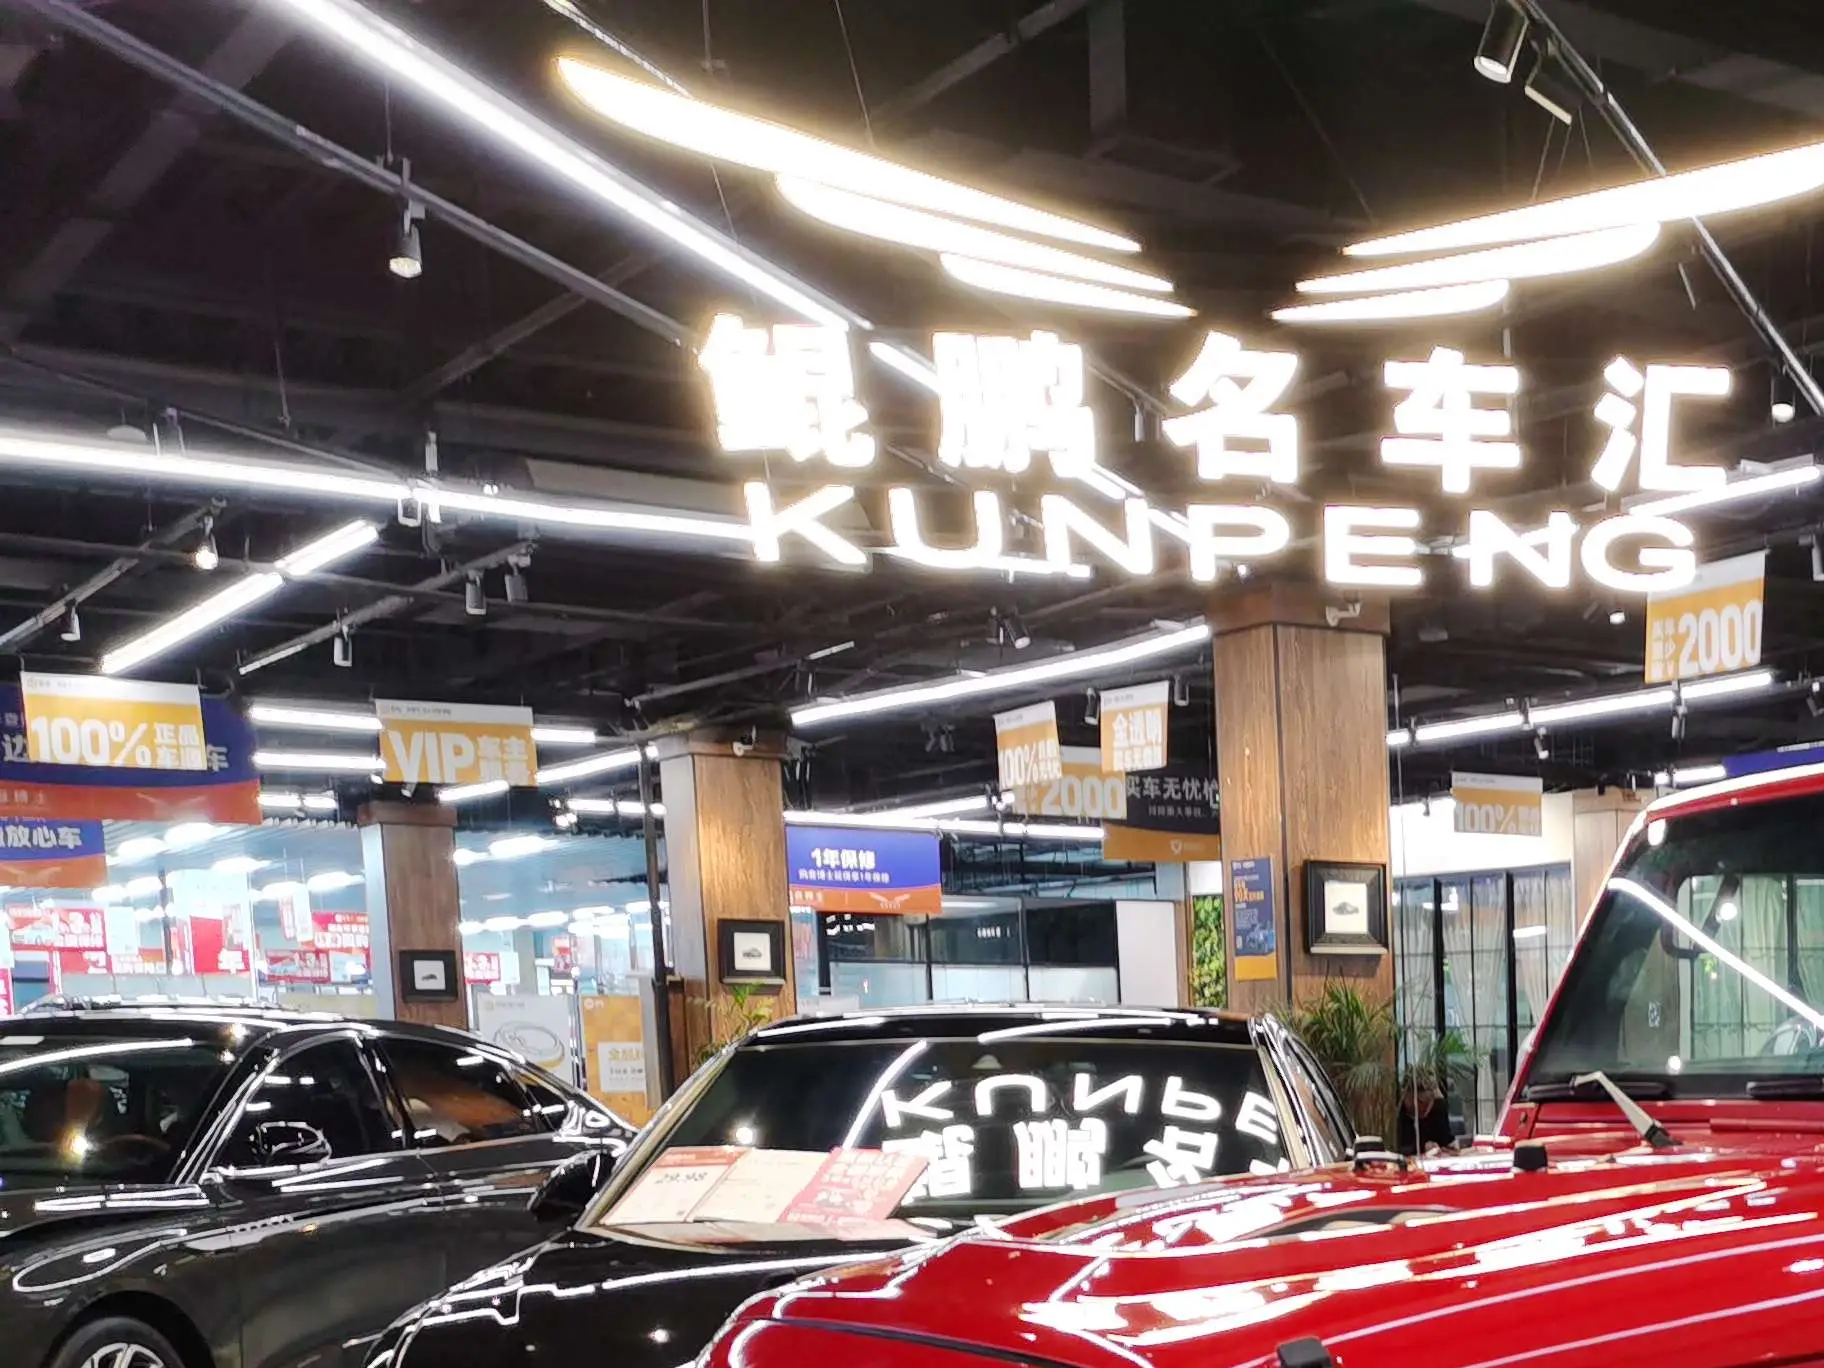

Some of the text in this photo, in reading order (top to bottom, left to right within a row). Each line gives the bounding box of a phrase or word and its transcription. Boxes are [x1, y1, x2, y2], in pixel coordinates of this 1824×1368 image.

[696, 310, 1734, 495] 鲲鹏名车汇
[739, 480, 1704, 594] KUNPENG
[1677, 599, 1762, 679] 2000
[31, 715, 152, 768] 100%
[388, 730, 475, 786] VIP
[999, 742, 1039, 789] 100%
[1041, 775, 1125, 819] 2000
[1454, 803, 1517, 834] 100%
